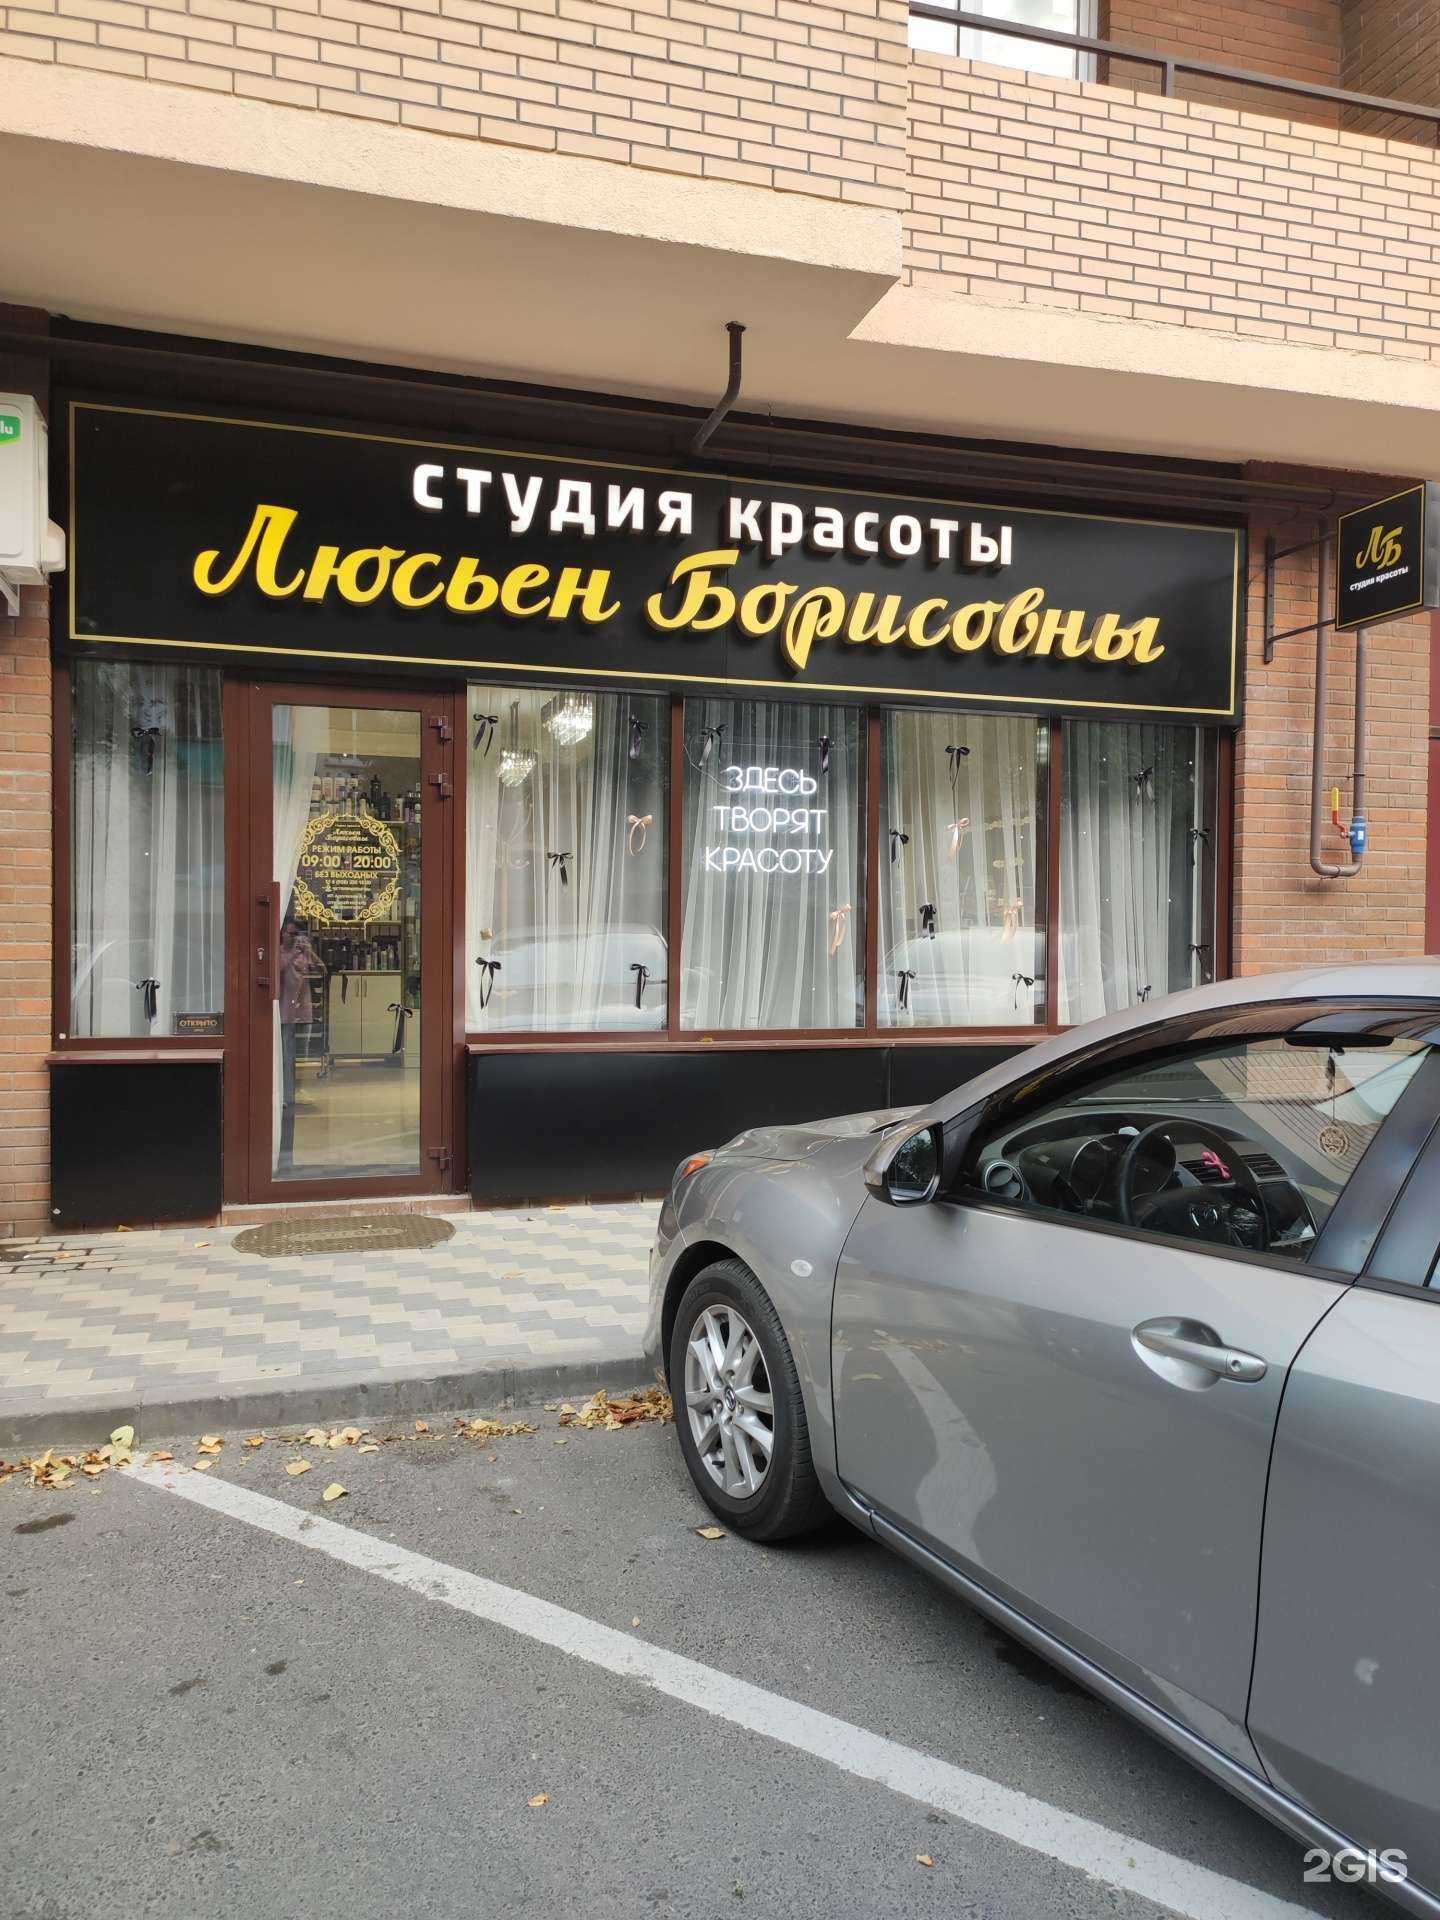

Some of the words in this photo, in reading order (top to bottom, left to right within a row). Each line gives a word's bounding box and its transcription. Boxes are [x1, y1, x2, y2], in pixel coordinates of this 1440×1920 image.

[413, 464, 693, 536] студия
[730, 497, 1012, 565] красоты
[1355, 525, 1403, 570] ЛБ
[193, 504, 620, 623] Люсьен
[647, 549, 1165, 670] Борисовны
[1350, 577, 1375, 591] студия
[1376, 566, 1409, 583] красоты
[724, 766, 817, 795] ЗДЕСЬ
[713, 806, 828, 834] ТВОРЯТ
[302, 855, 340, 867] 09:00
[353, 856, 391, 868] 20:00
[312, 845, 345, 853] РЕЖИМ
[347, 846, 382, 854] РАБОТЫ
[705, 846, 834, 874] КРАСОТУ
[330, 871, 378, 879] ВЫХОДНЫХ
